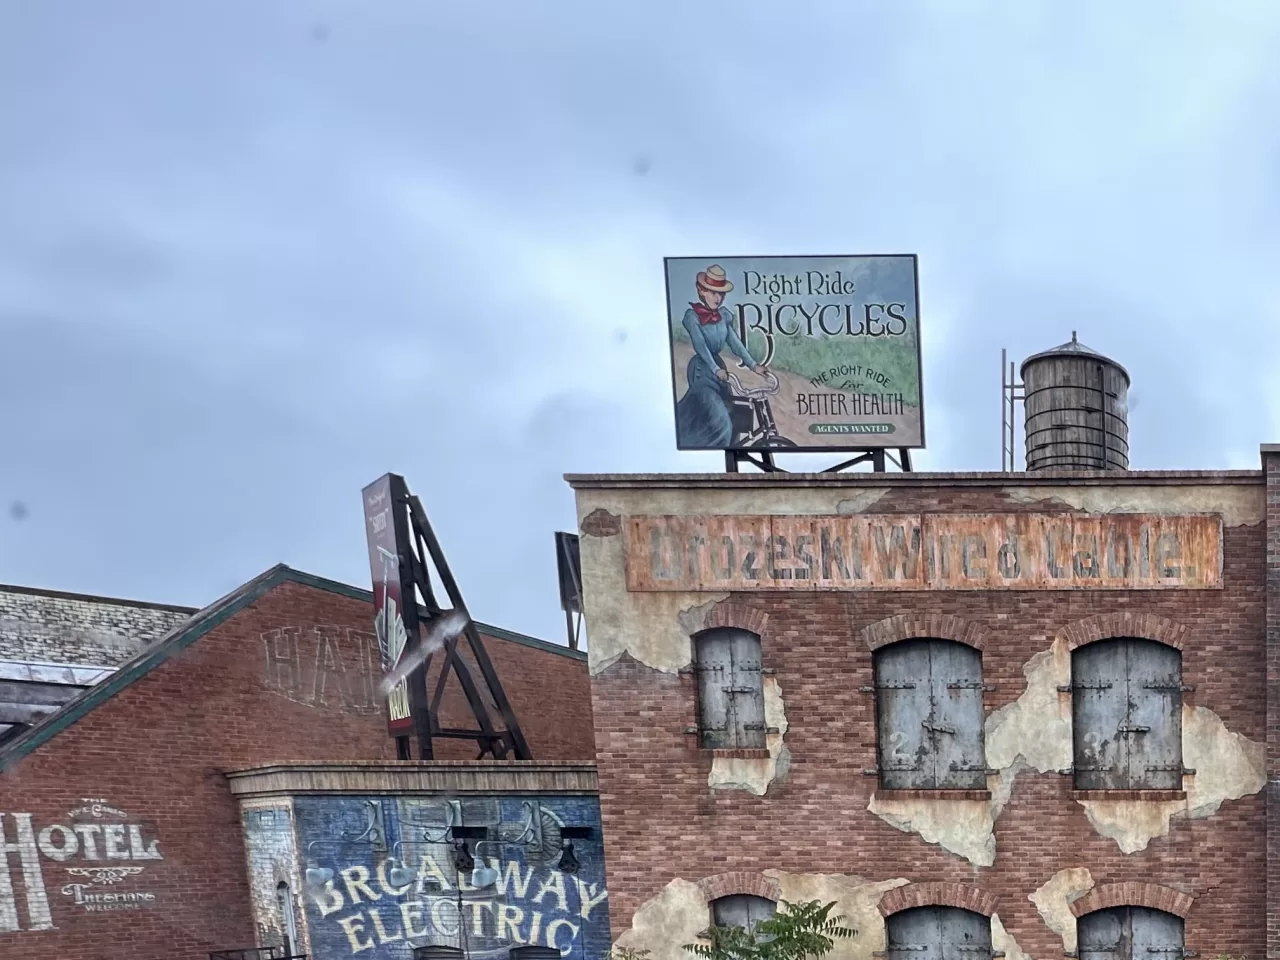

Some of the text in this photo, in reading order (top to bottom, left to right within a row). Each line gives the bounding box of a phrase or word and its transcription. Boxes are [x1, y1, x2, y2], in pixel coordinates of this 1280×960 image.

[743, 271, 855, 303] Right Ride
[735, 303, 907, 368] BICYCLES
[810, 364, 891, 389] THE RIGHT RIDE
[839, 379, 864, 389] for
[796, 392, 905, 416] BETTER HEALTH
[815, 425, 889, 433] AGENTS WANTED
[337, 899, 580, 957] ELECTRIC
